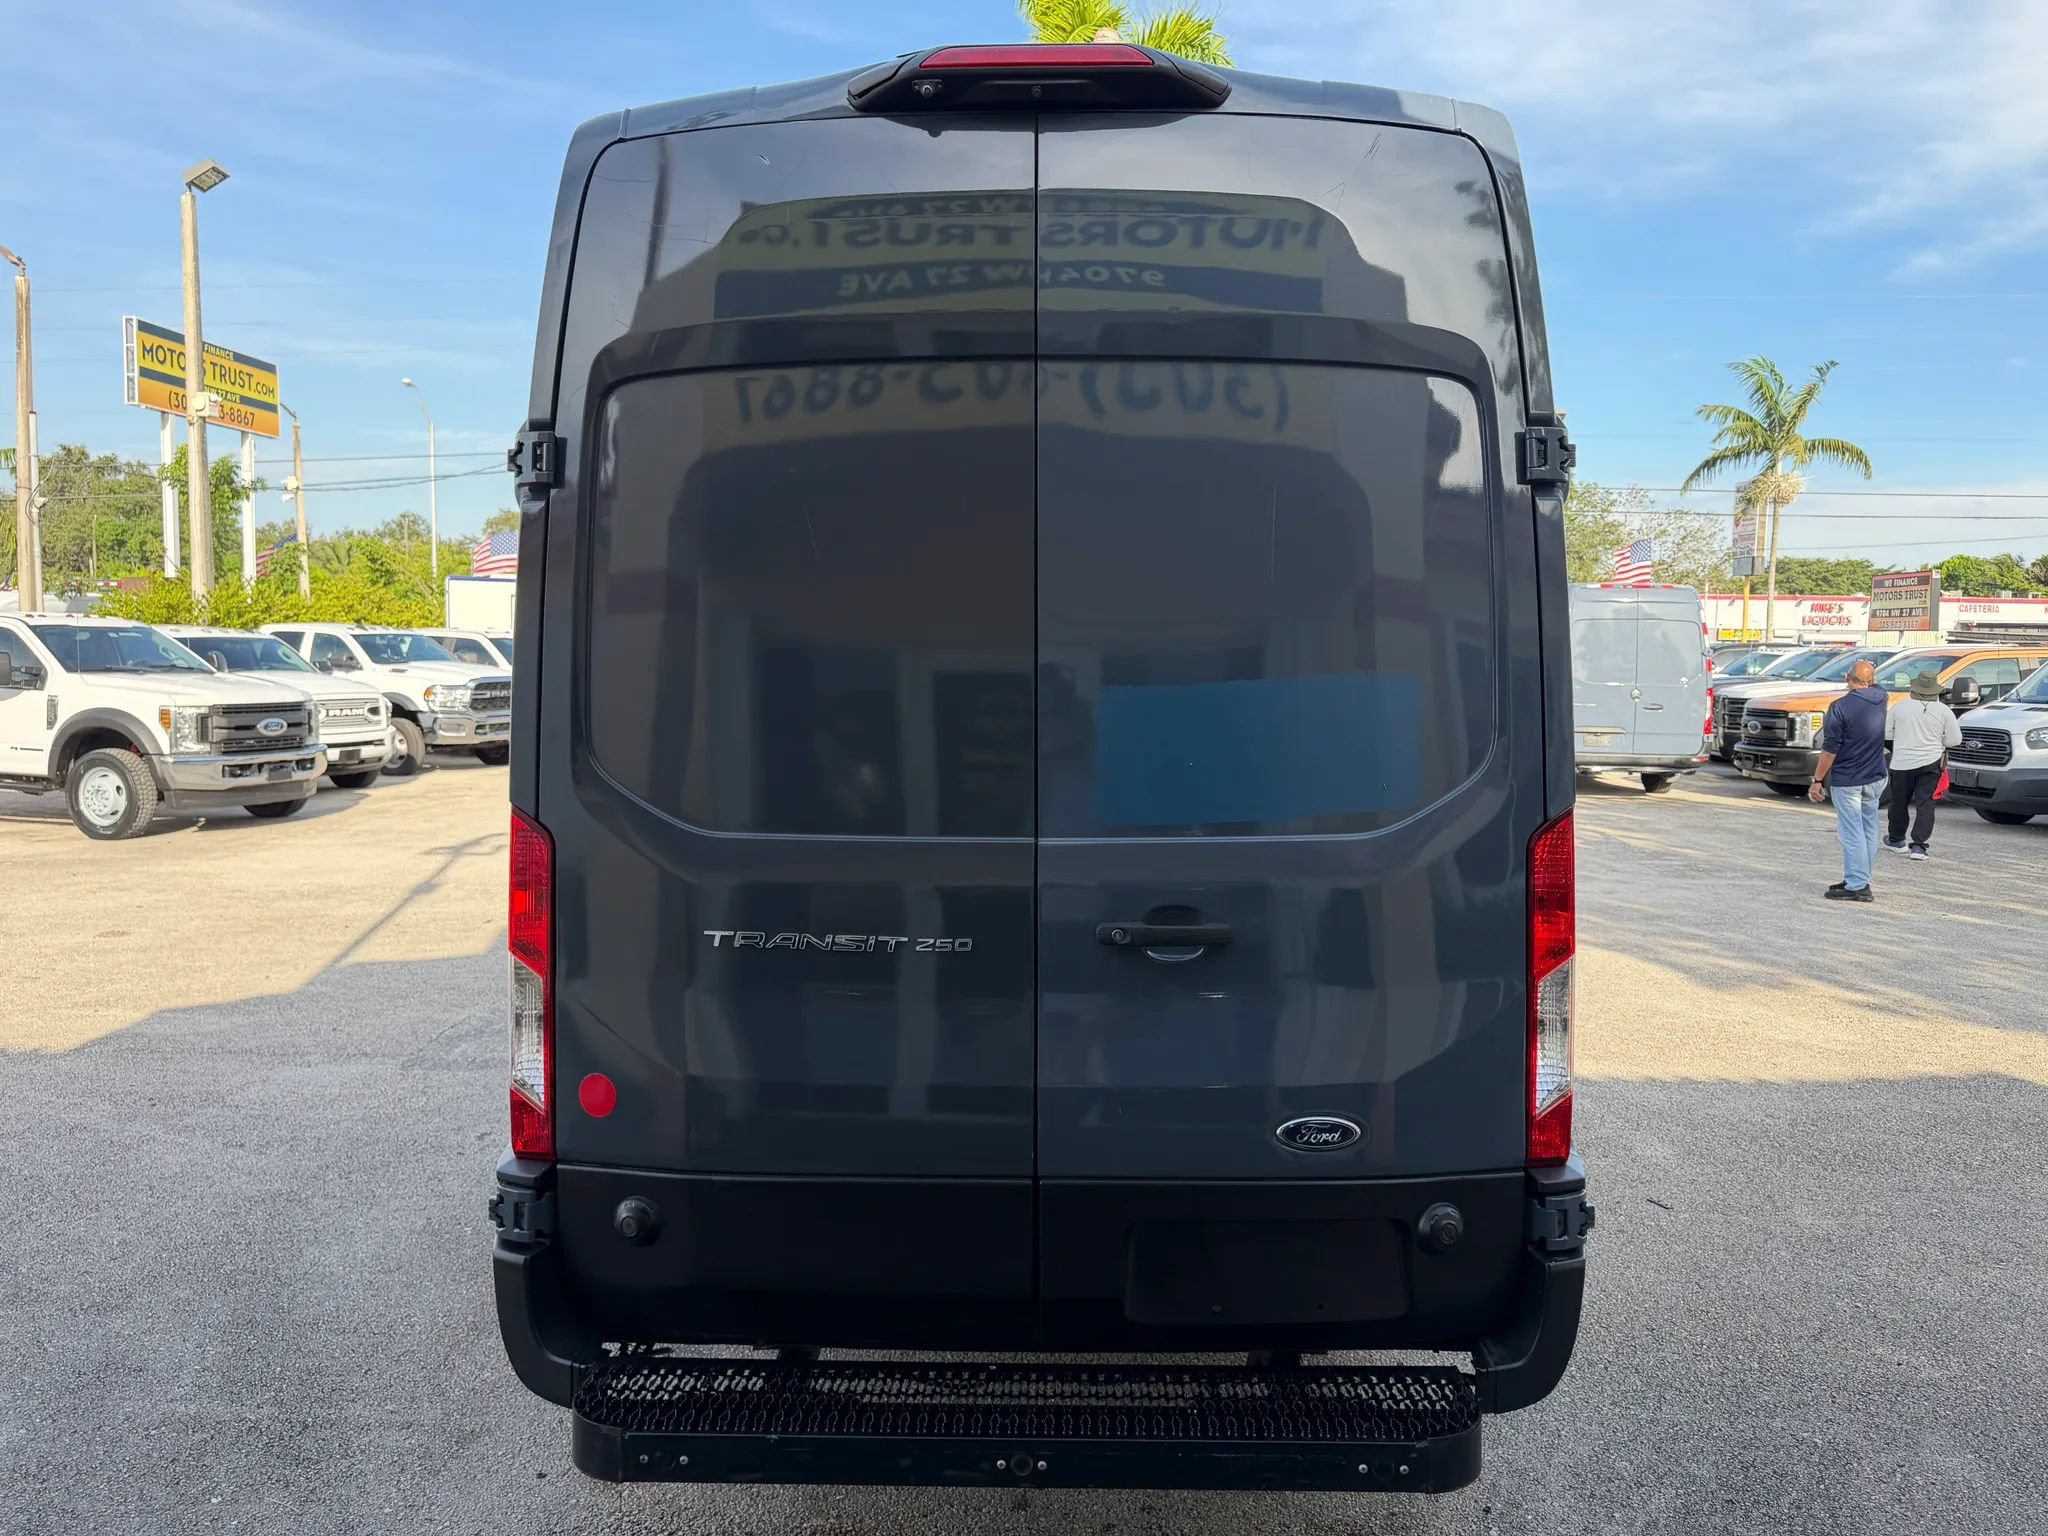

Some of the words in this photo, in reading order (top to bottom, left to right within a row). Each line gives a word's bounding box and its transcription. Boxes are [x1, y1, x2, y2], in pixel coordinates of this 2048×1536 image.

[204, 343, 234, 361] FINANCE
[227, 393, 241, 403] AVE
[1894, 577, 1918, 587] FINANCE
[1873, 590, 1903, 601] MOTORS
[1905, 588, 1928, 600] TRUST
[1810, 602, 1844, 614] MIKE'S
[1891, 609, 1900, 617] NW
[1902, 608, 1909, 617] 27
[1911, 607, 1923, 616] AVE
[1959, 604, 2000, 613] CAFETERIA
[1801, 615, 1852, 626] LIQUORS
[328, 708, 364, 717] RAM
[704, 930, 909, 952] TRANSIT
[915, 938, 972, 951] 250
[1297, 1124, 1342, 1143] Ford
